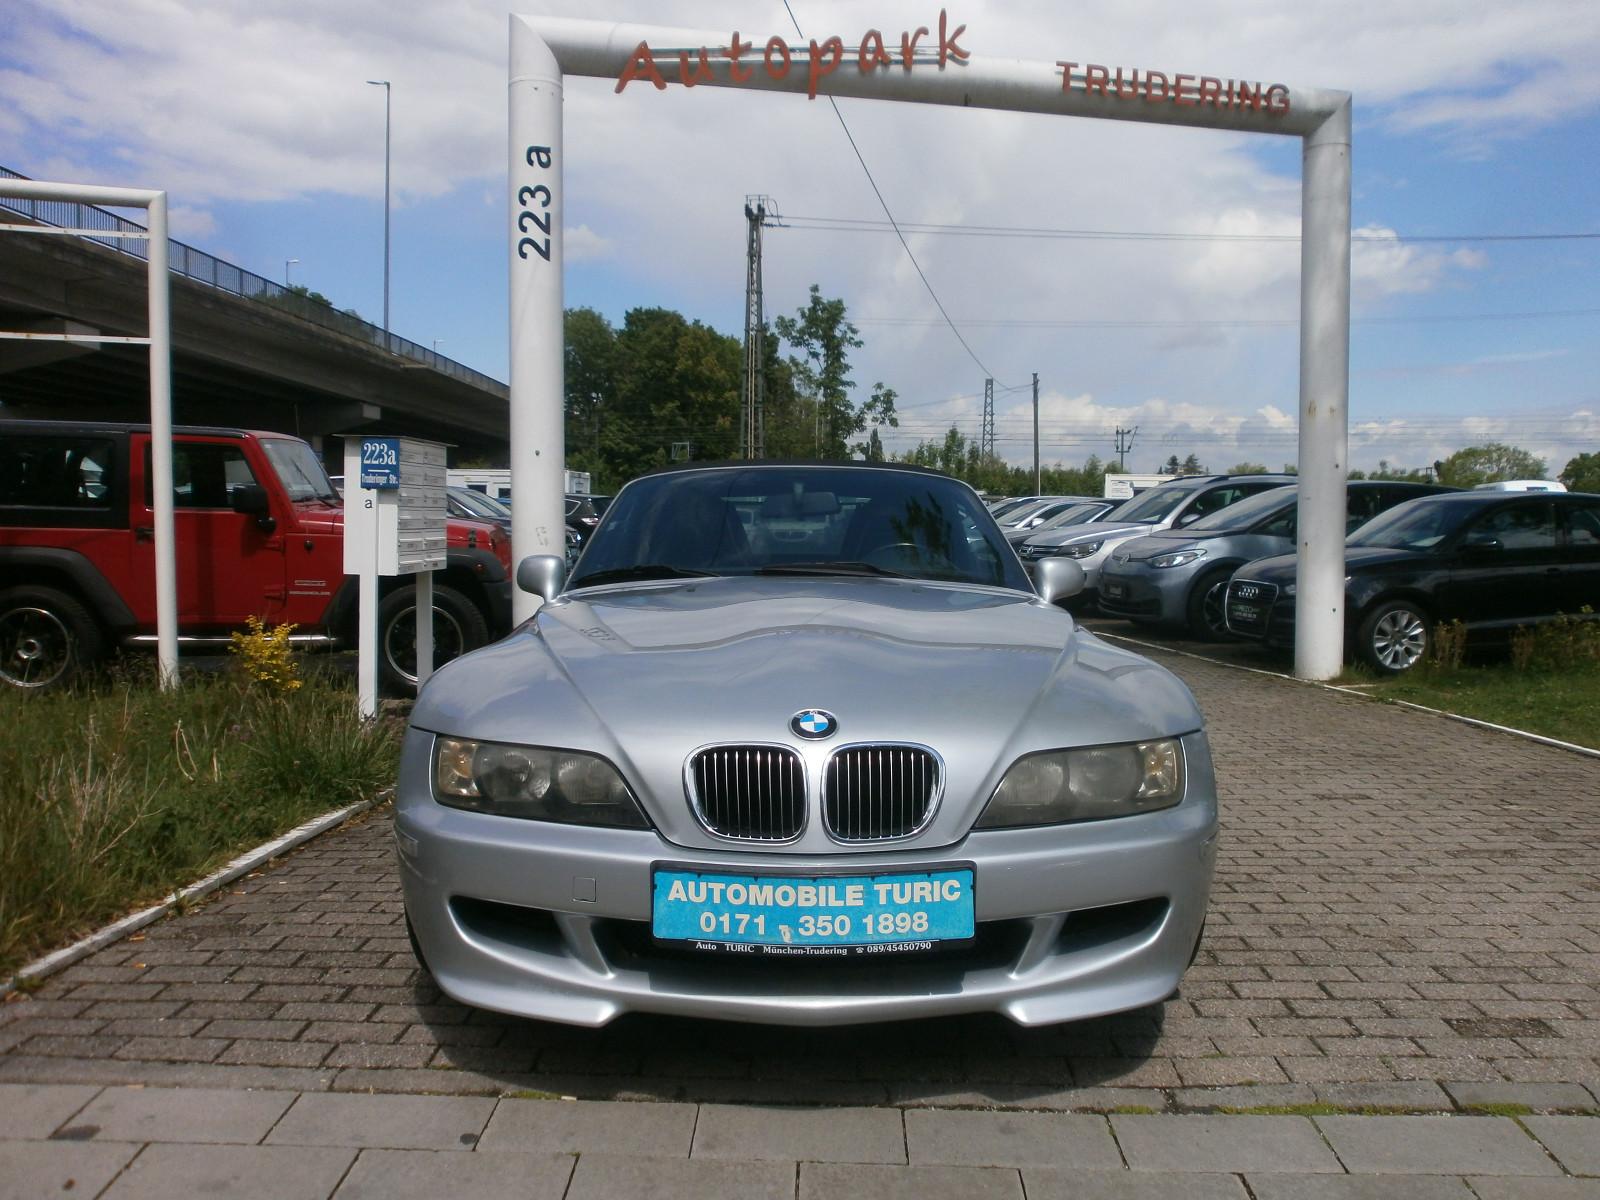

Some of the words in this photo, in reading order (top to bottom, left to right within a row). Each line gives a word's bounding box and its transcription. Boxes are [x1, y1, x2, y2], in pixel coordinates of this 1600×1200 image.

[615, 8, 971, 100] Autopark
[1056, 60, 1291, 113] TRUDERING
[526, 145, 551, 169] a
[518, 184, 551, 262] 223
[362, 442, 397, 465] 223a
[364, 499, 373, 509] a
[667, 879, 865, 907] AUTOMOBILE
[873, 879, 961, 905] TURIC
[699, 911, 766, 936] 0171
[798, 914, 851, 937] 350
[862, 911, 930, 936] 1898
[695, 941, 717, 951] Auto
[724, 943, 755, 953] TURIC
[763, 945, 848, 956] München-Trudering
[866, 941, 932, 953] 089/45450790
